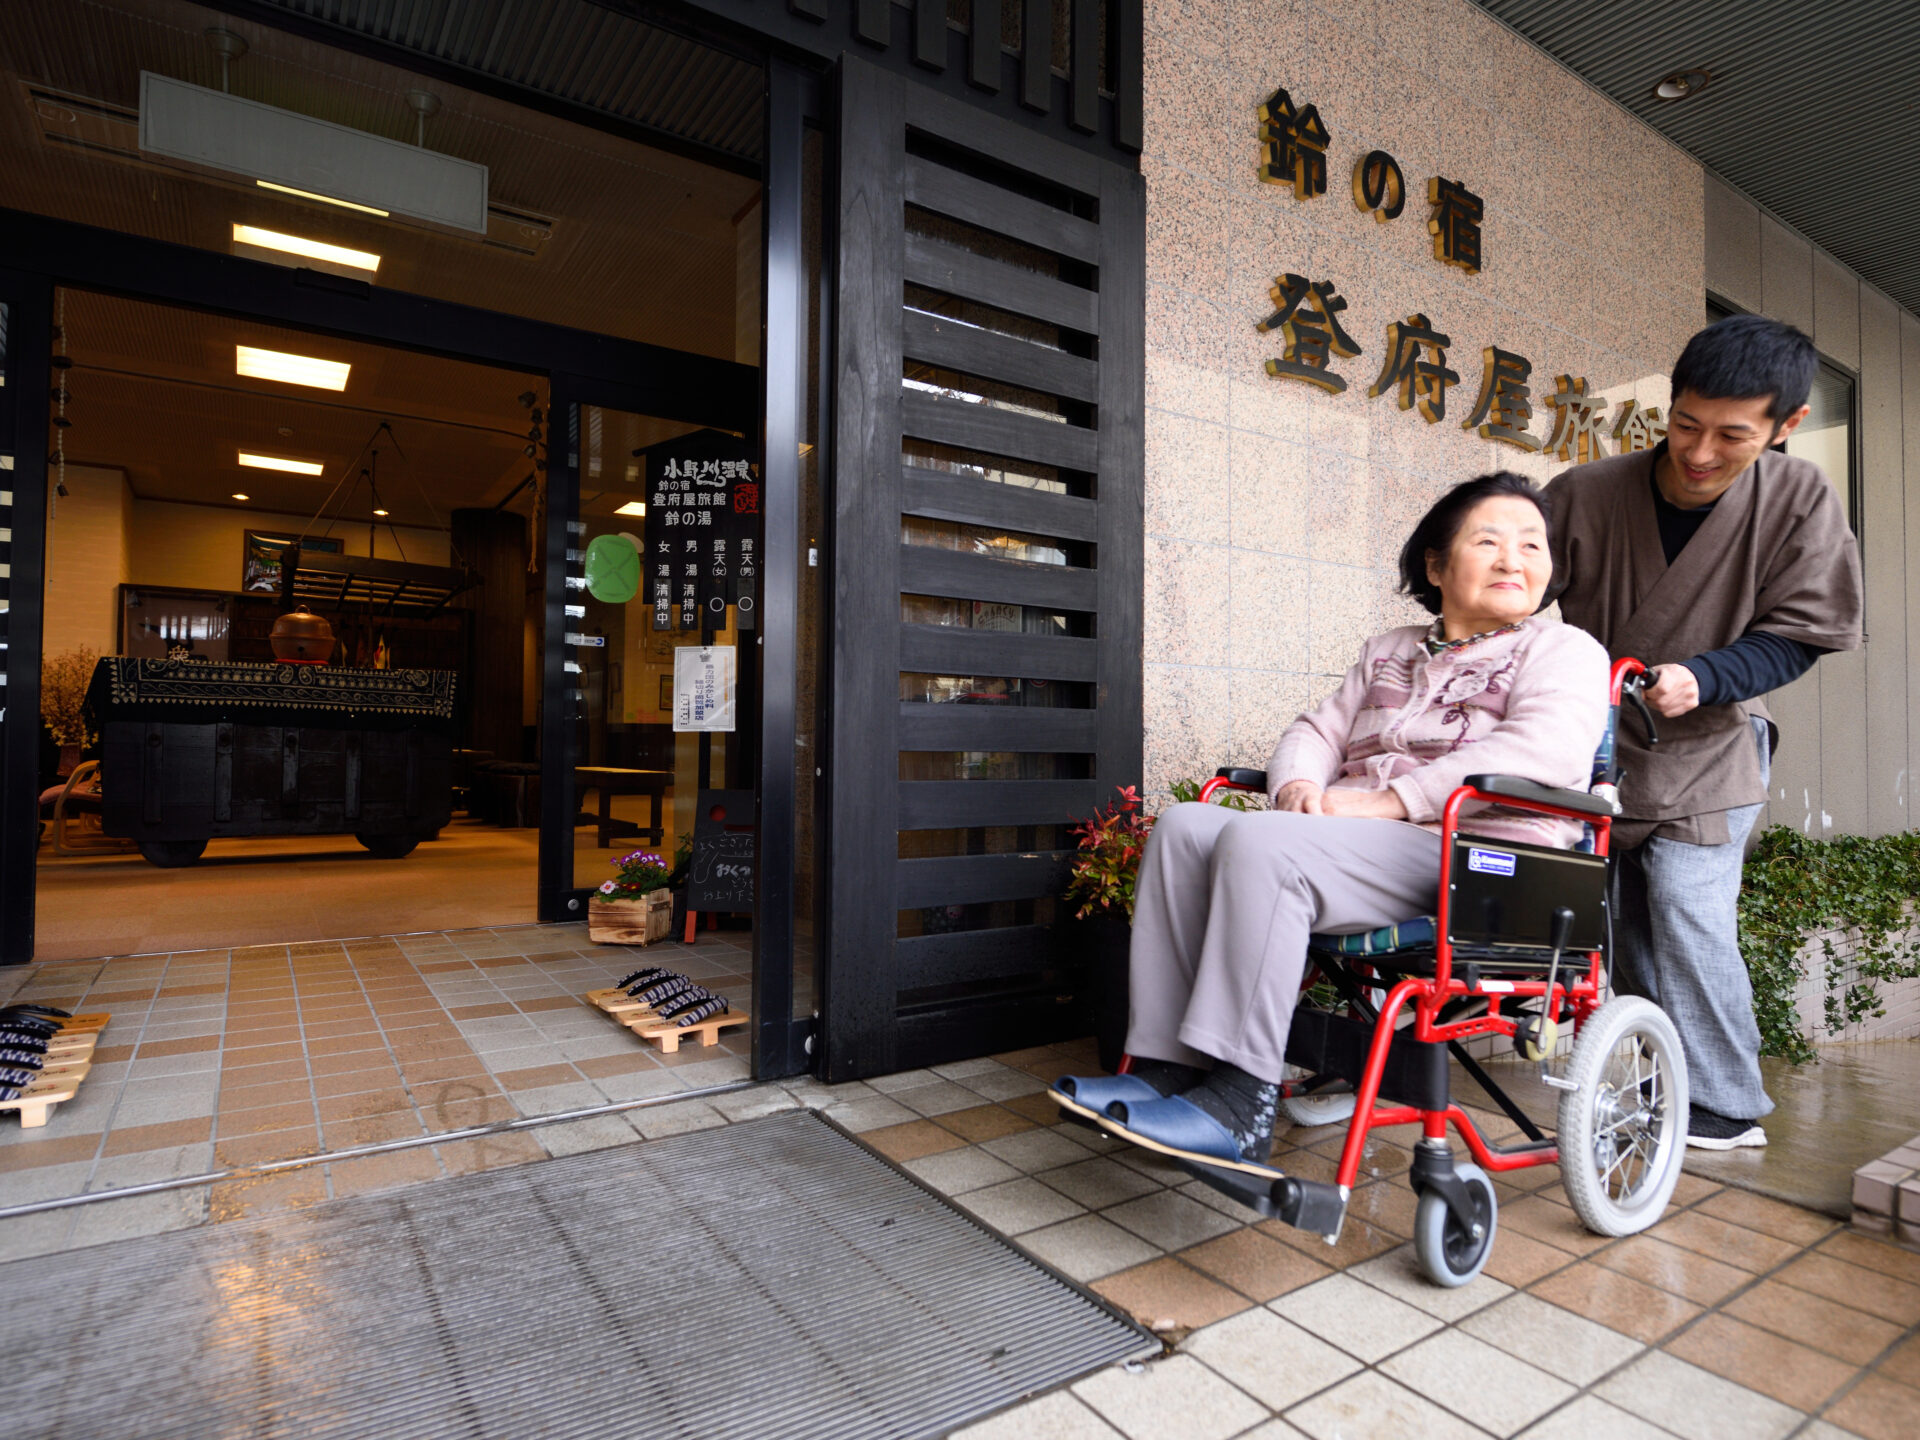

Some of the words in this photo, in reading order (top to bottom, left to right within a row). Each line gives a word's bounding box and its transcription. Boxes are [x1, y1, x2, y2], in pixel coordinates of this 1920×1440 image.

[1258, 87, 1484, 275] 鈴の宿
[658, 480, 690, 491] 鈴の宿
[664, 458, 752, 487] 小野川温泉
[653, 492, 727, 506] 登府屋旅館
[664, 510, 712, 526] 鈴の湯
[658, 540, 671, 577] 女湯
[685, 540, 697, 577] 男湯
[656, 583, 669, 625] 清掃中
[683, 583, 695, 625] 清掃中
